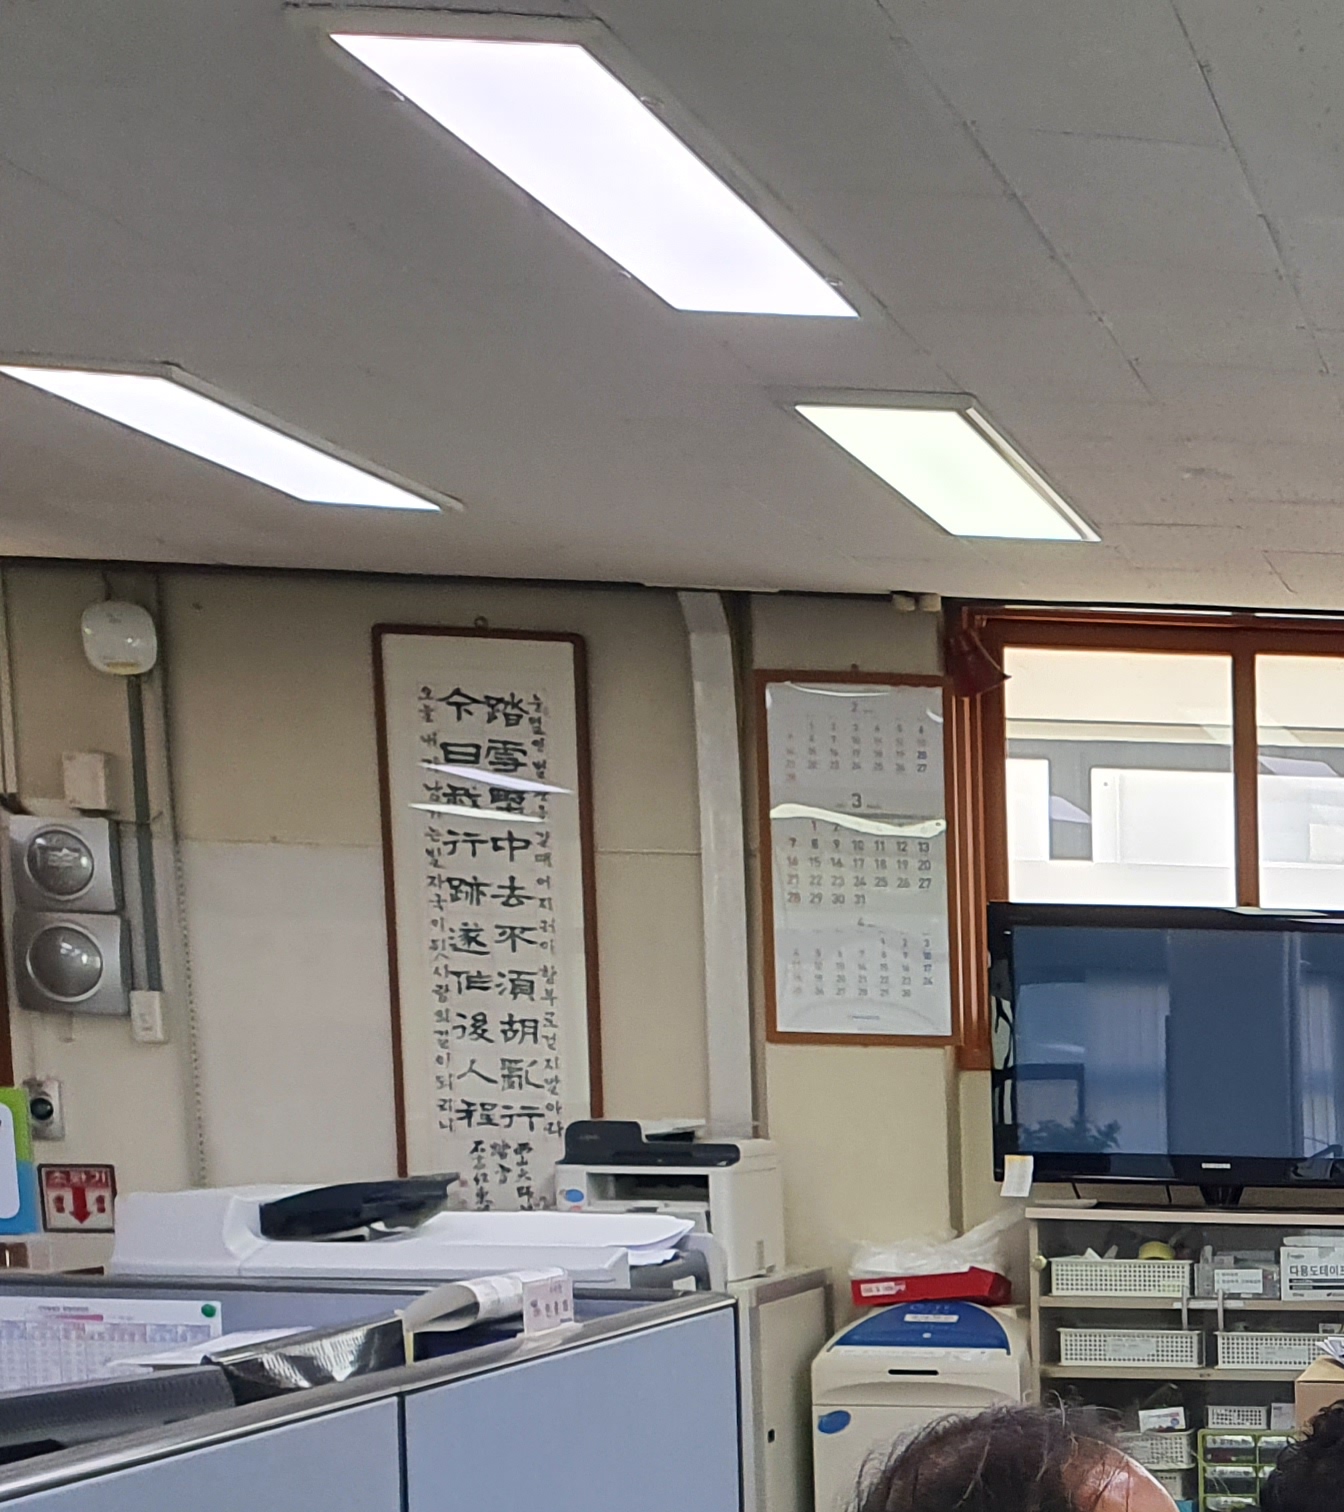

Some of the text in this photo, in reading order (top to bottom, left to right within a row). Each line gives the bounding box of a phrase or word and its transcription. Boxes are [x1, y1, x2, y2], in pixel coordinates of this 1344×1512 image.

[917, 763, 927, 772] 27
[851, 793, 862, 808] 3
[811, 838, 819, 849] 8
[833, 839, 840, 849] 9
[852, 840, 864, 851] 10
[874, 840, 885, 851] 11
[896, 841, 908, 852] 12
[918, 842, 929, 853] 13
[809, 857, 821, 867] 15
[853, 858, 864, 869] 17
[875, 859, 887, 870] 18
[897, 859, 908, 870] 19
[918, 860, 931, 871] 20
[809, 874, 822, 886] 22
[831, 875, 845, 887] 23
[854, 876, 867, 887] 24
[875, 876, 888, 888] 25
[897, 877, 910, 888] 26
[918, 878, 932, 889] 27
[810, 892, 823, 904] 29
[832, 893, 845, 904] 30
[854, 894, 865, 905] 31
